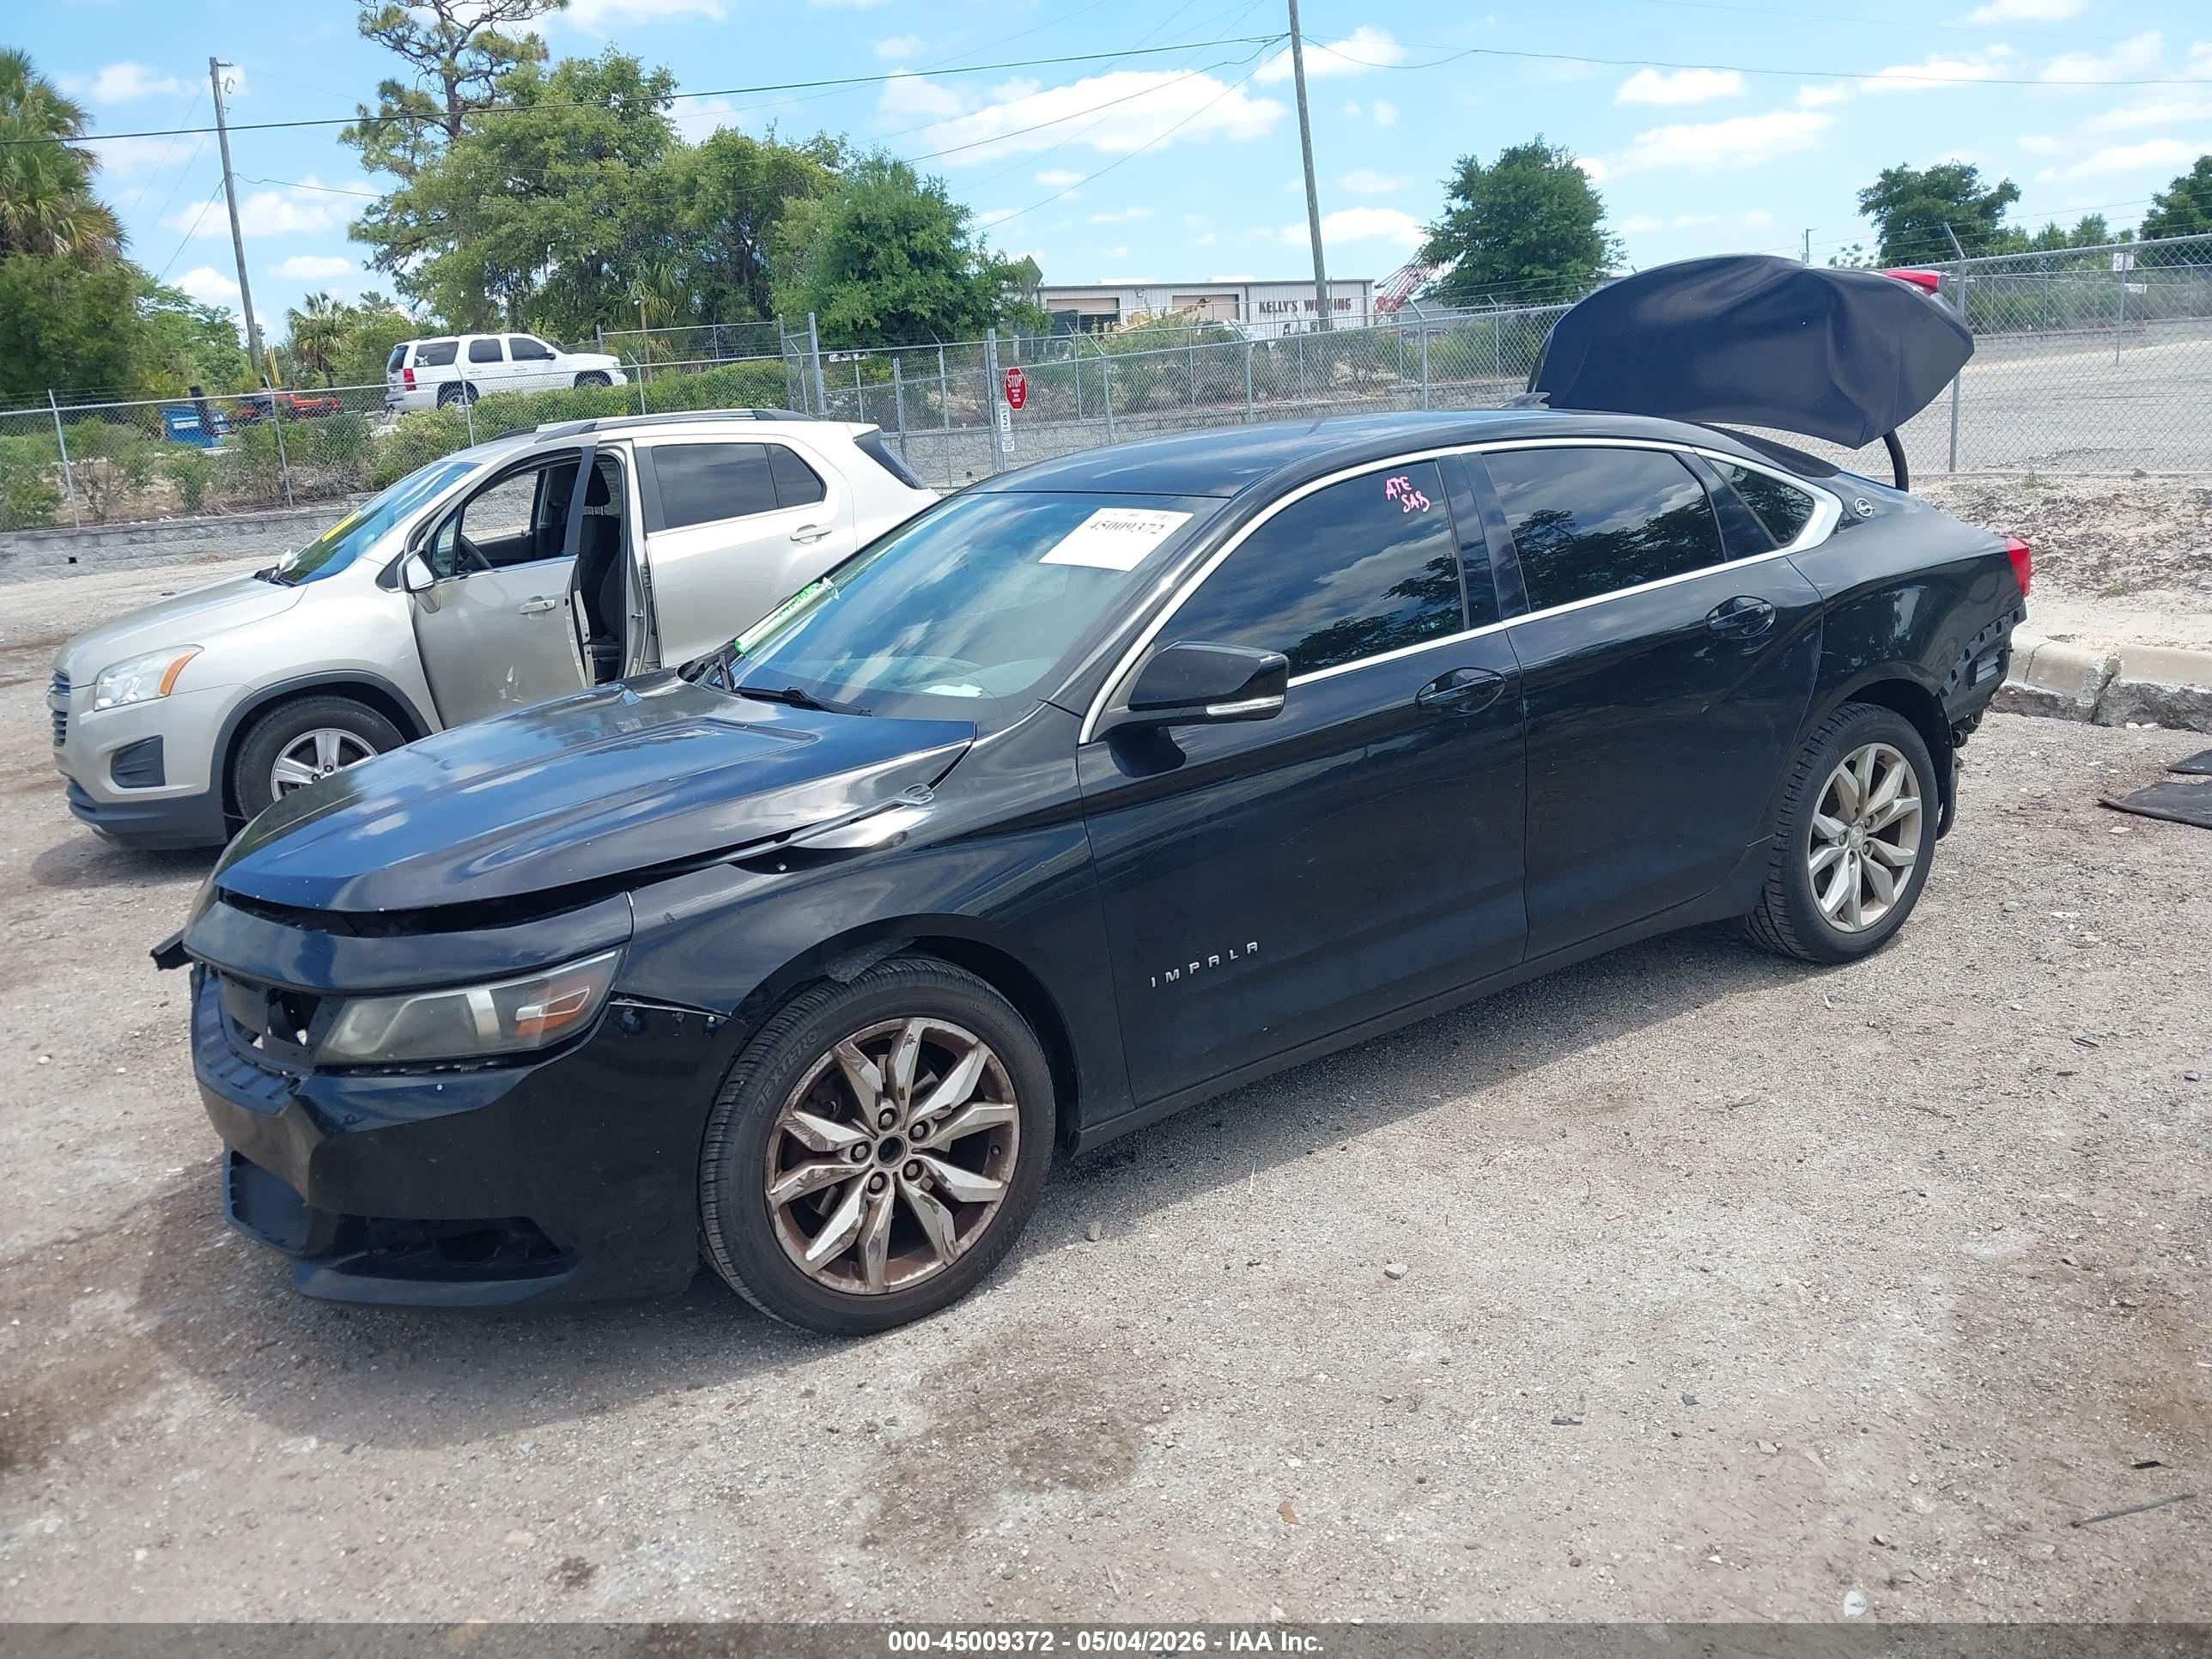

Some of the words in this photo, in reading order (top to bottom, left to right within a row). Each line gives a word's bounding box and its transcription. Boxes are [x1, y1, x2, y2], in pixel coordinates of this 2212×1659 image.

[1258, 300, 1298, 313] KELLY'S
[1304, 297, 1352, 311] WDING
[1007, 374, 1023, 388] STOP
[1385, 476, 1413, 501] ATE
[1089, 520, 1165, 534] 45009372
[1151, 941, 1259, 988] IMPALA
